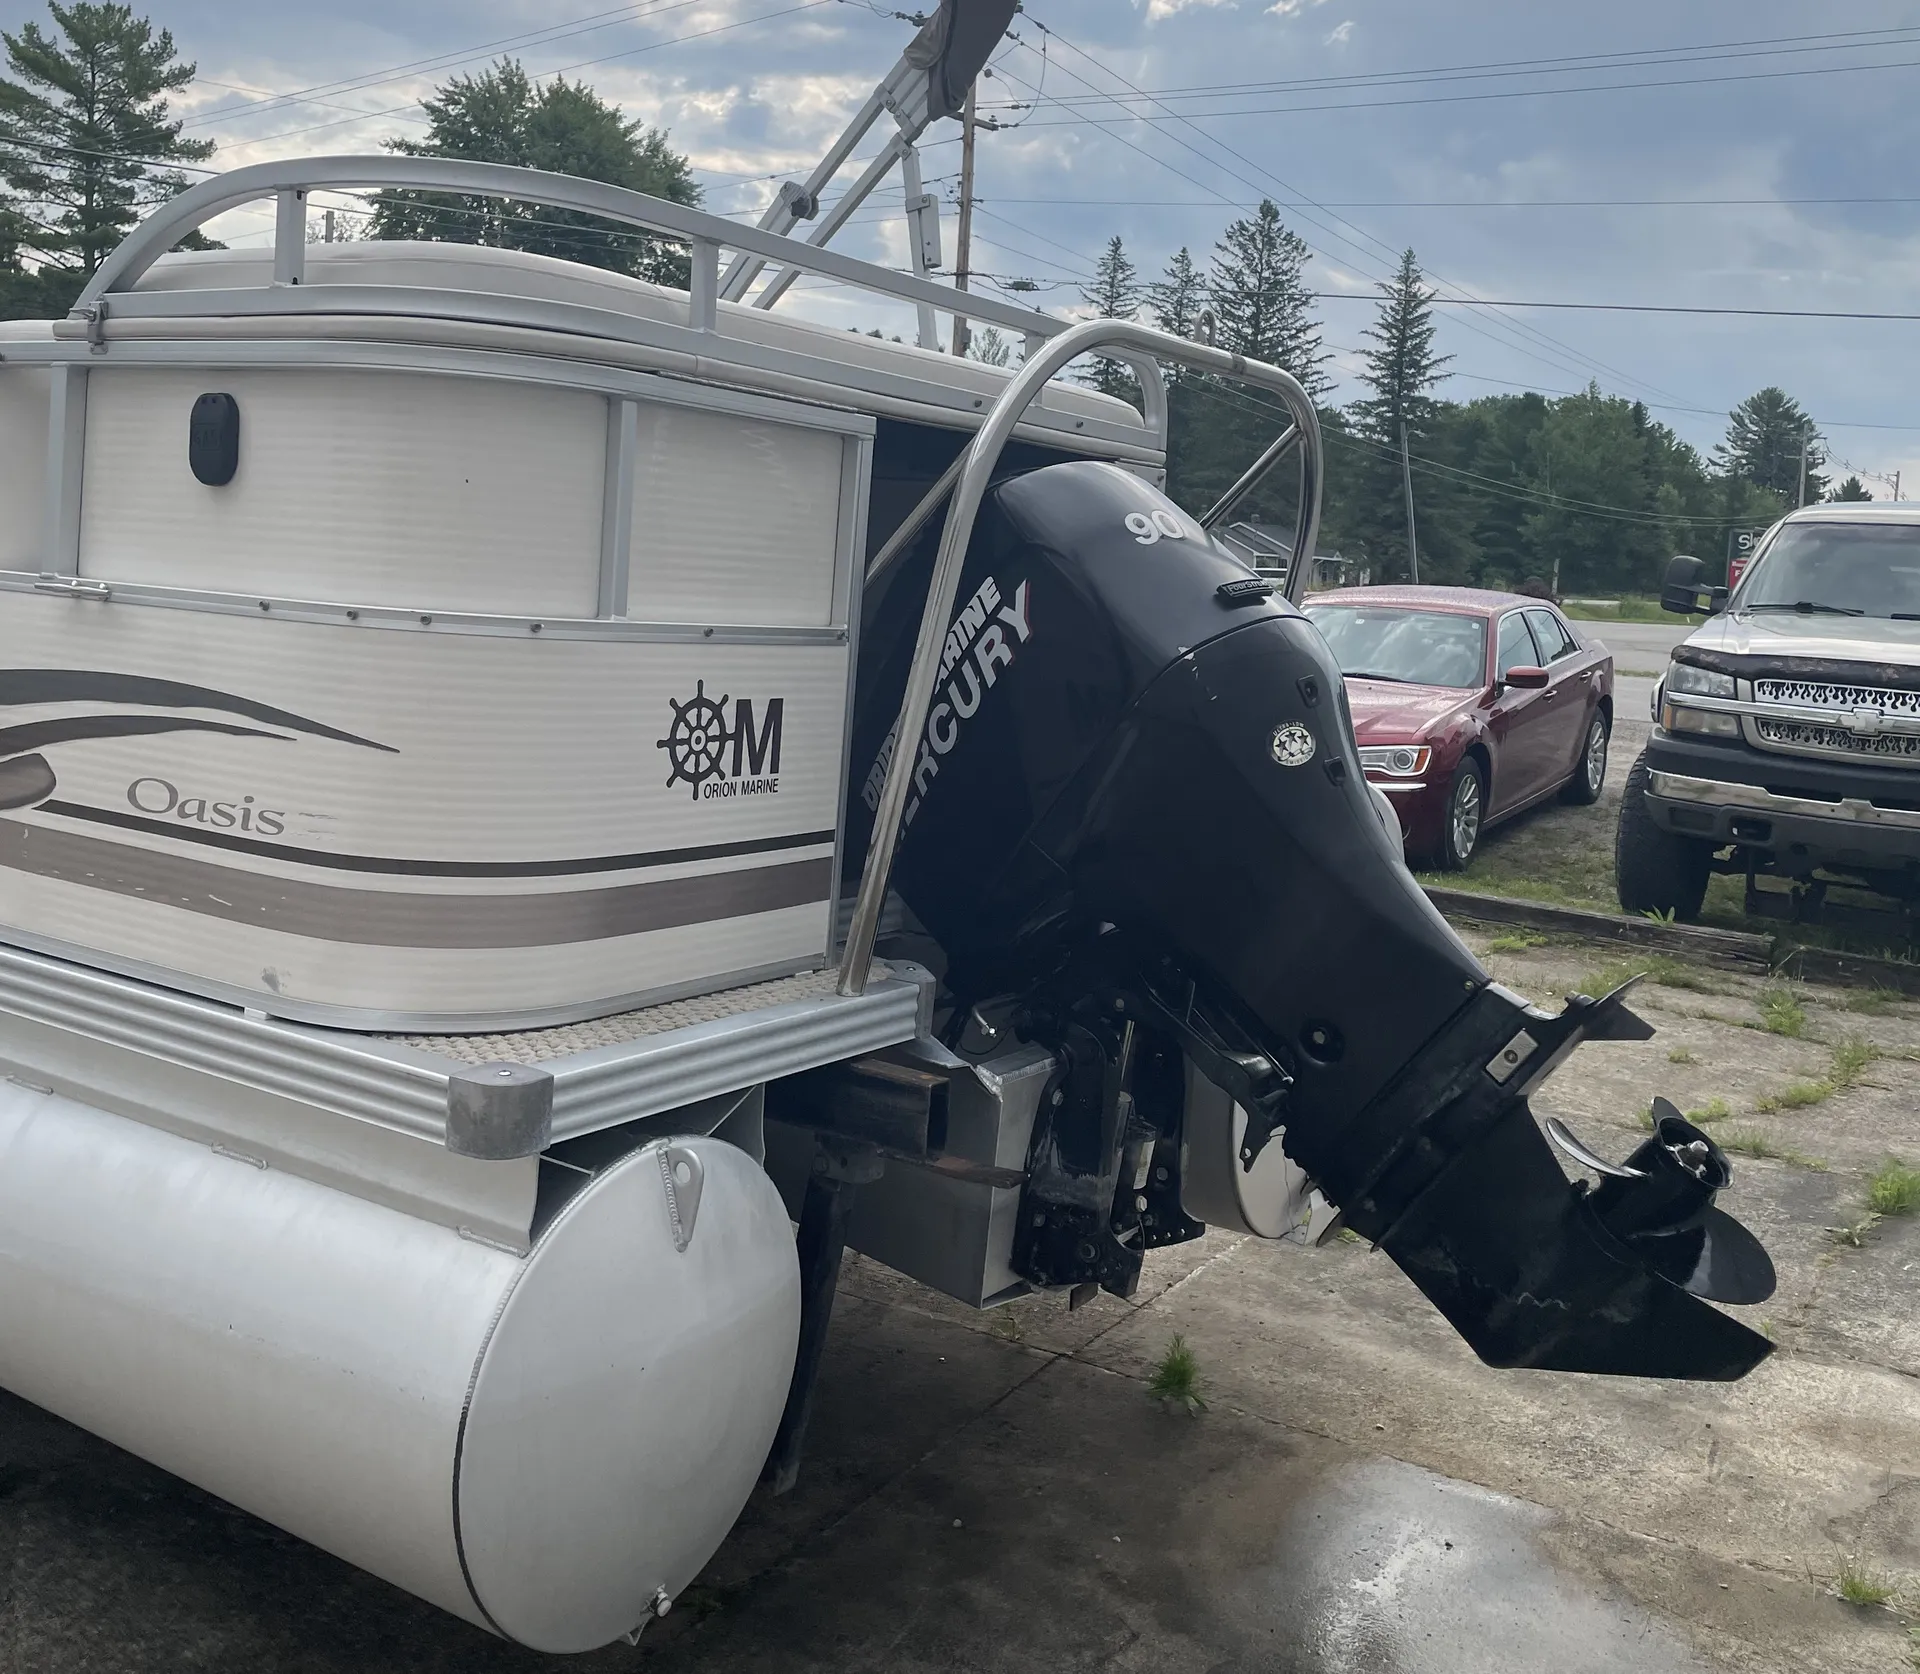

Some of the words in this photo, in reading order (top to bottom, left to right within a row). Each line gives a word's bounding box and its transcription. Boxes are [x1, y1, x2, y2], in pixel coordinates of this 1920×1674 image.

[1124, 509, 1185, 545] 90
[127, 777, 285, 836] Oasis
[703, 781, 737, 799] ORION
[740, 778, 779, 796] MARINE
